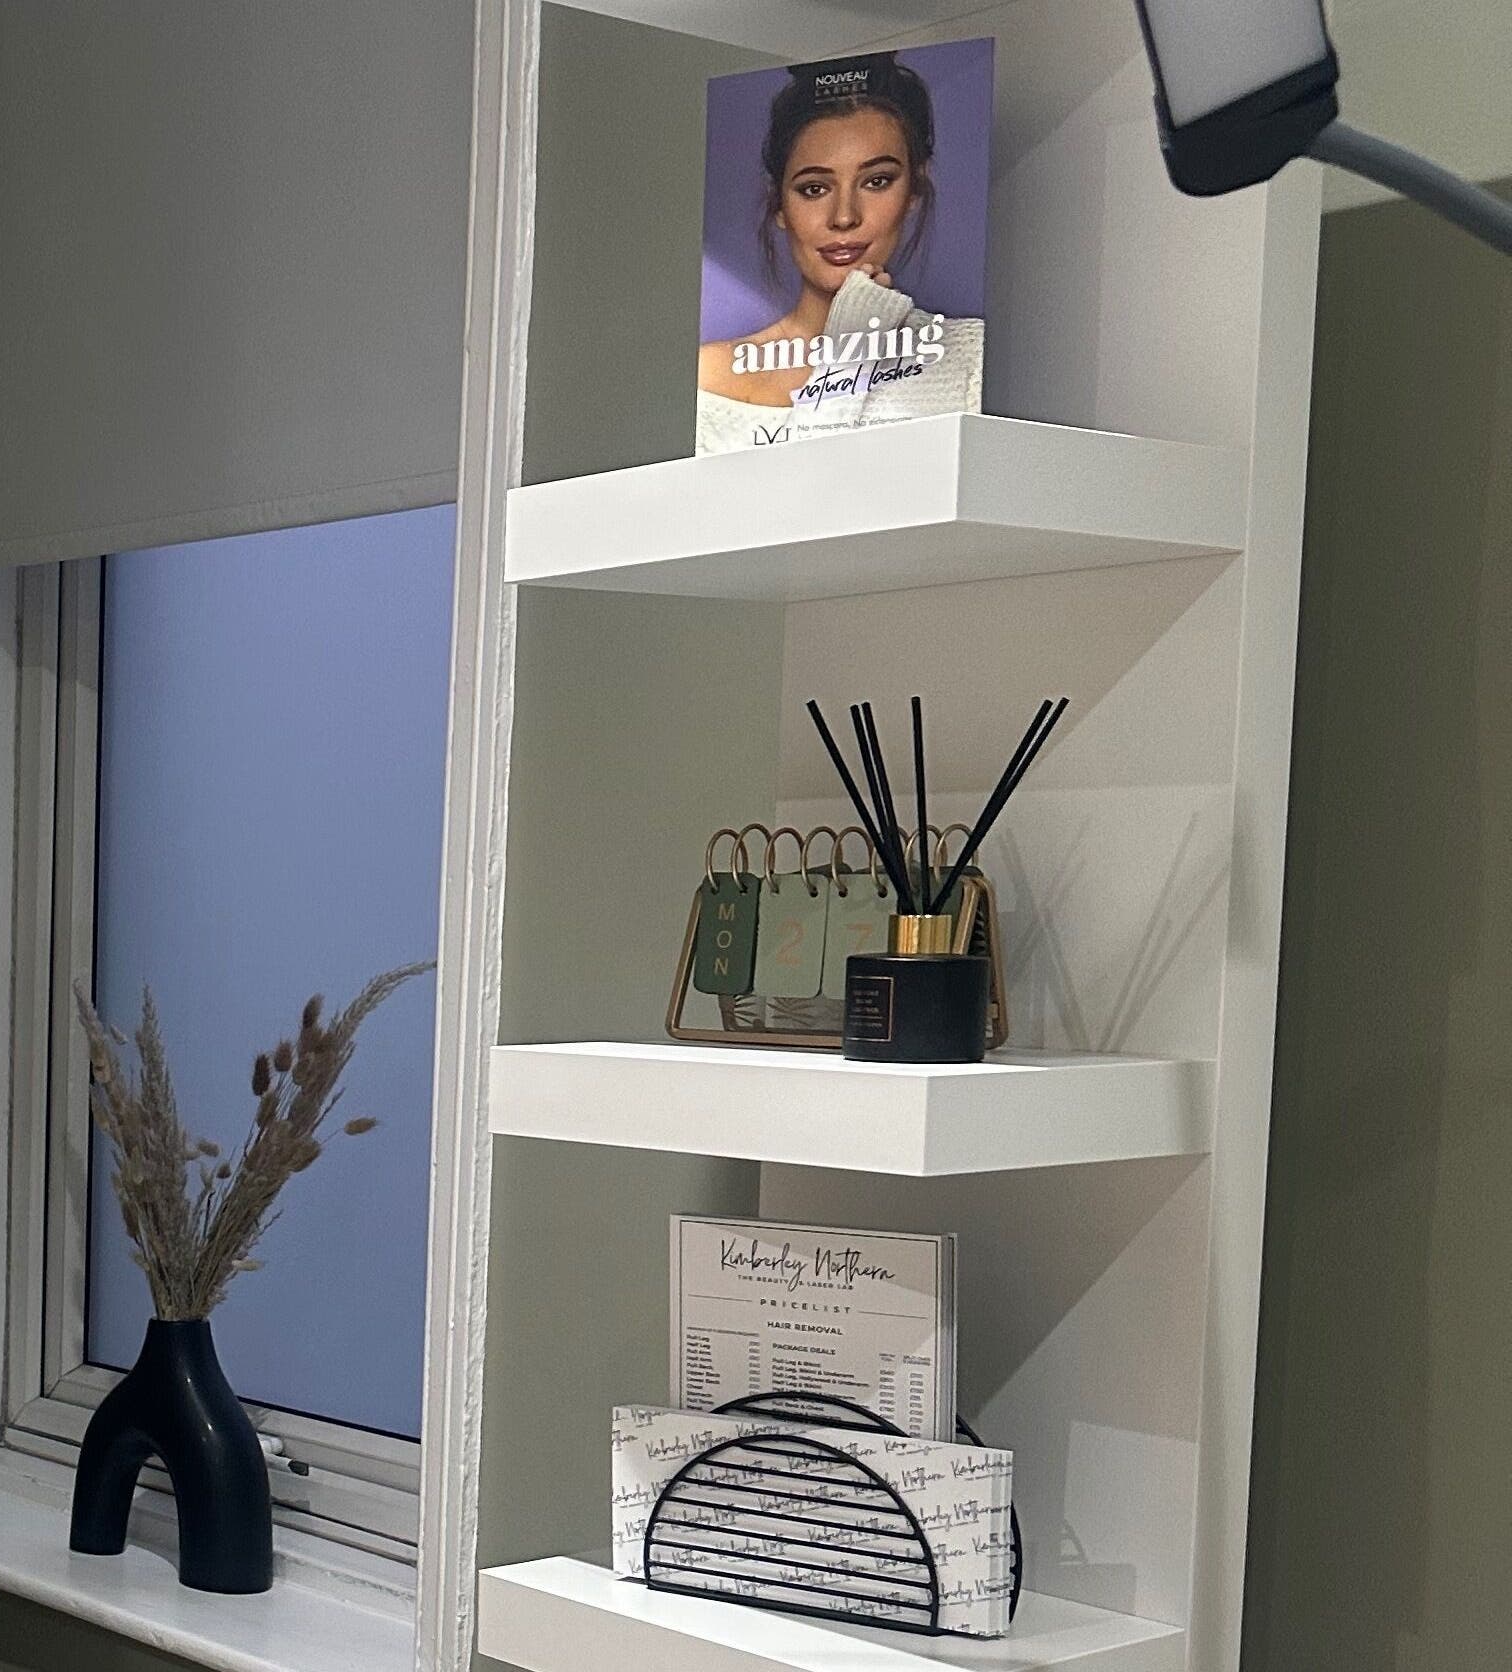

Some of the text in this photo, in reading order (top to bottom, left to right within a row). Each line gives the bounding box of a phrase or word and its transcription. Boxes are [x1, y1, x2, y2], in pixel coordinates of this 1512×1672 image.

[815, 70, 869, 87] NOUVEAU
[731, 313, 945, 375] amazing
[797, 357, 923, 411] natural lashes
[797, 424, 810, 432] No
[853, 416, 867, 427] No
[713, 903, 735, 976] MON
[775, 917, 804, 967] 2
[719, 1237, 896, 1293] Kimberley Northern
[737, 1274, 753, 1282] THE
[756, 1275, 789, 1285] BEAUTY
[807, 1281, 834, 1289] LASER
[759, 1298, 852, 1314] PRICELIST
[767, 1320, 844, 1336] HAIR REMOVAL
[772, 1342, 836, 1356] PACKAGE DEALS
